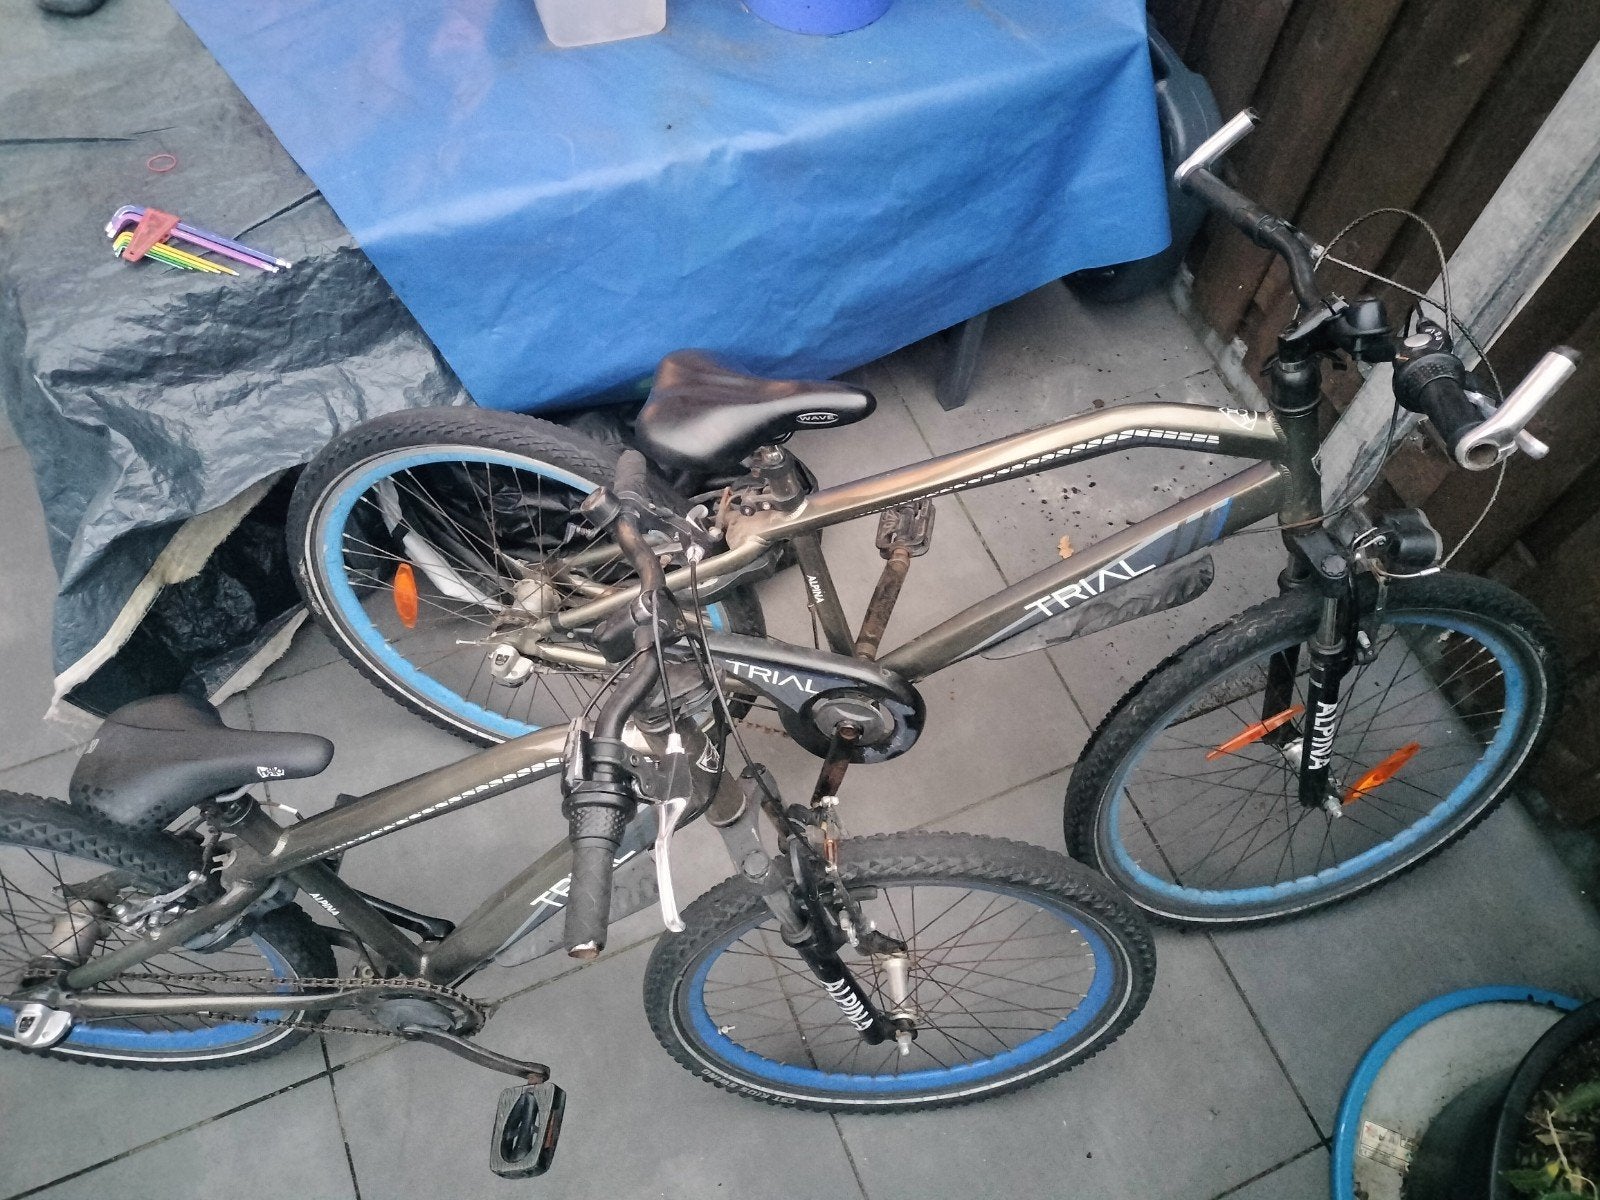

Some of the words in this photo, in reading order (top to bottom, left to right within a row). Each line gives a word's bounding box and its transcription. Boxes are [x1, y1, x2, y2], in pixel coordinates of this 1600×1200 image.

[806, 574, 825, 603] ALPINA
[1023, 559, 1157, 617] TRIAL
[725, 659, 820, 695] TRIAL
[1308, 701, 1338, 770] ALPINA
[308, 893, 341, 916] ALPINA
[529, 850, 637, 907] TRL
[820, 978, 874, 1031] ALPINA
